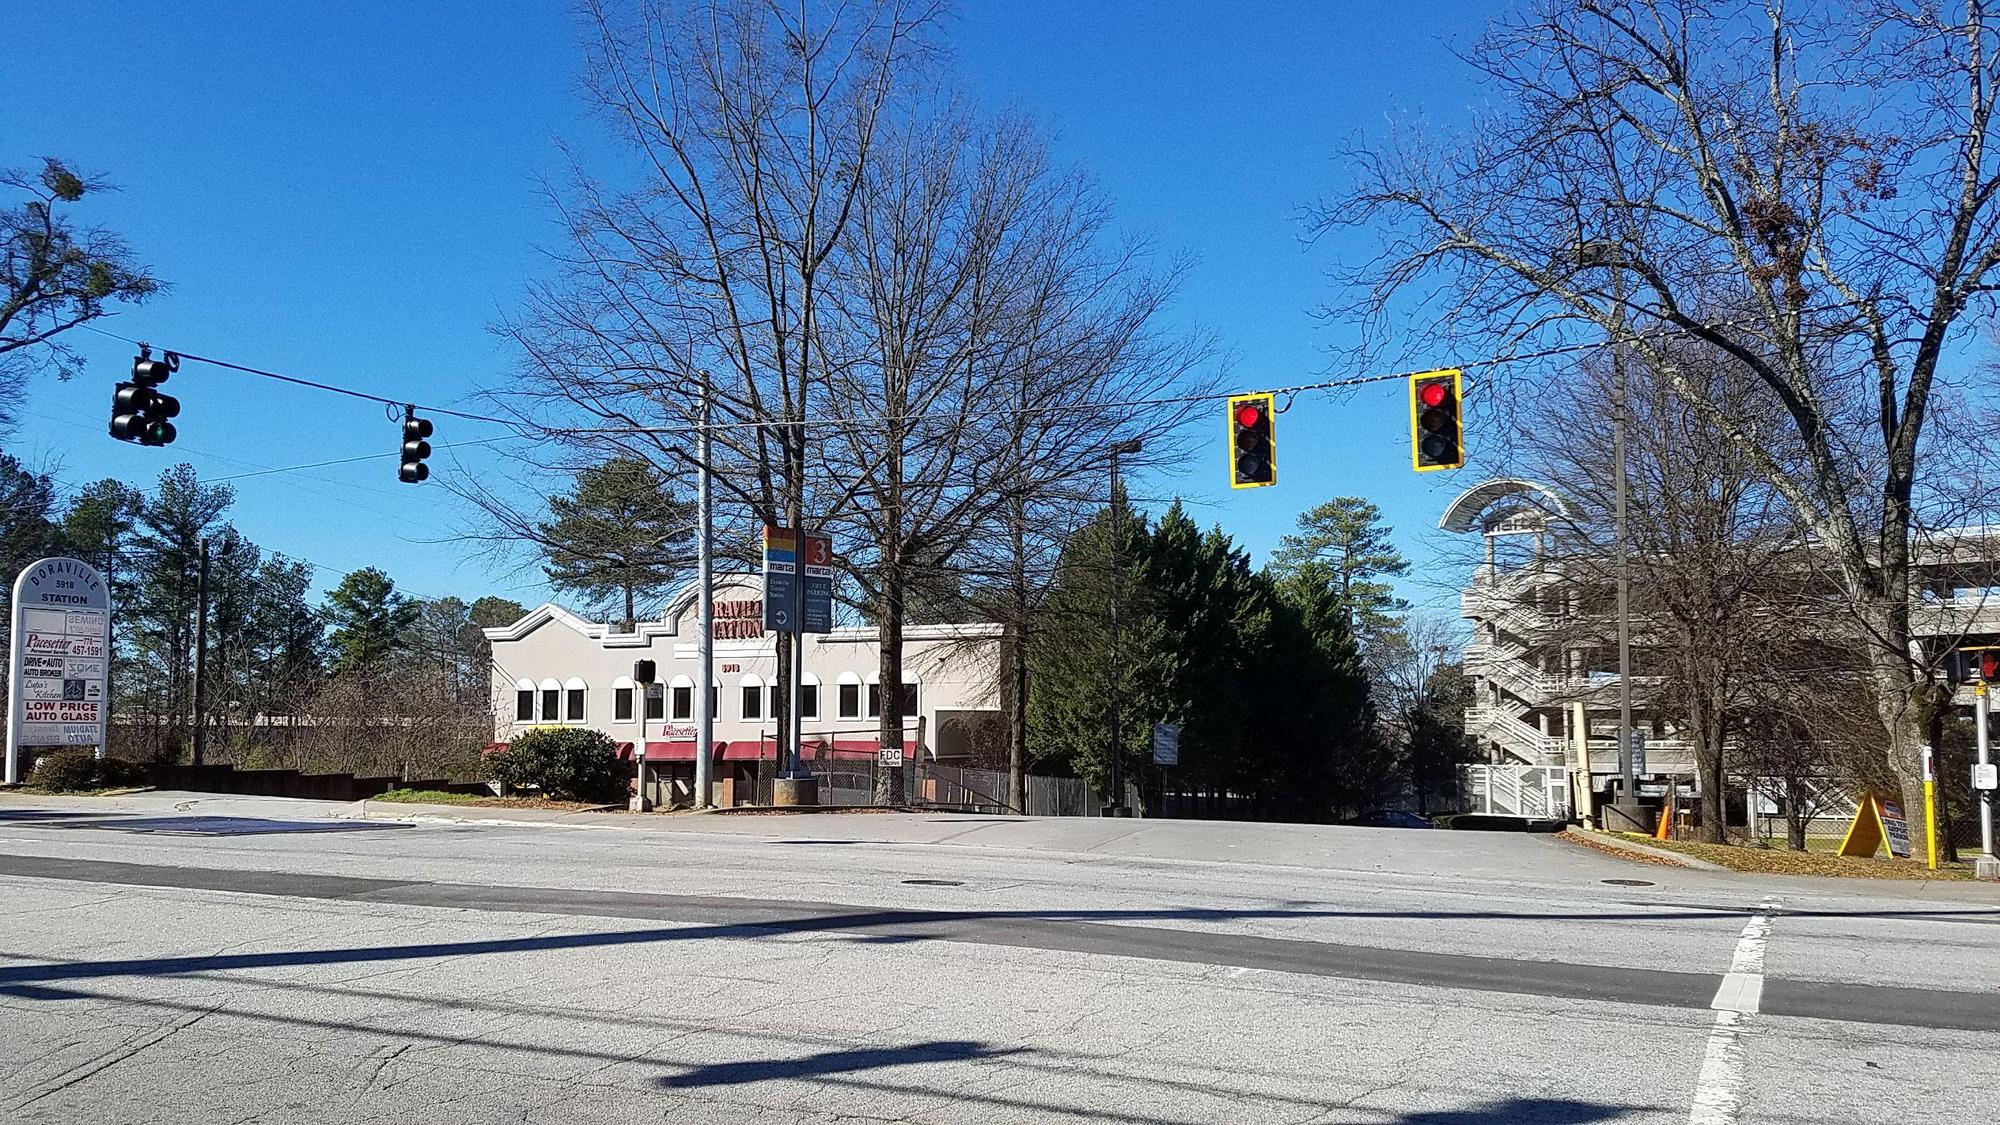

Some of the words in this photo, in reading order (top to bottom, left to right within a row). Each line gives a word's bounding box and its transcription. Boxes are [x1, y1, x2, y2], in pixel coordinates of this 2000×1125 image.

[814, 539, 827, 564] 3
[769, 562, 794, 573] marta
[806, 566, 831, 576] marta
[31, 562, 99, 591] DORAVILLE
[56, 580, 74, 590] 5918
[41, 594, 88, 605] STATION
[25, 634, 72, 650] Pacesetter
[71, 646, 103, 656] 457-1591
[46, 658, 63, 668] AUTO
[24, 668, 39, 677] AUTO
[40, 669, 62, 678] BROKER
[26, 702, 56, 711] LOW
[59, 703, 99, 712] PRICE
[26, 712, 58, 721] AUTO
[61, 713, 97, 722] GLASS
[880, 750, 901, 760] FDC
